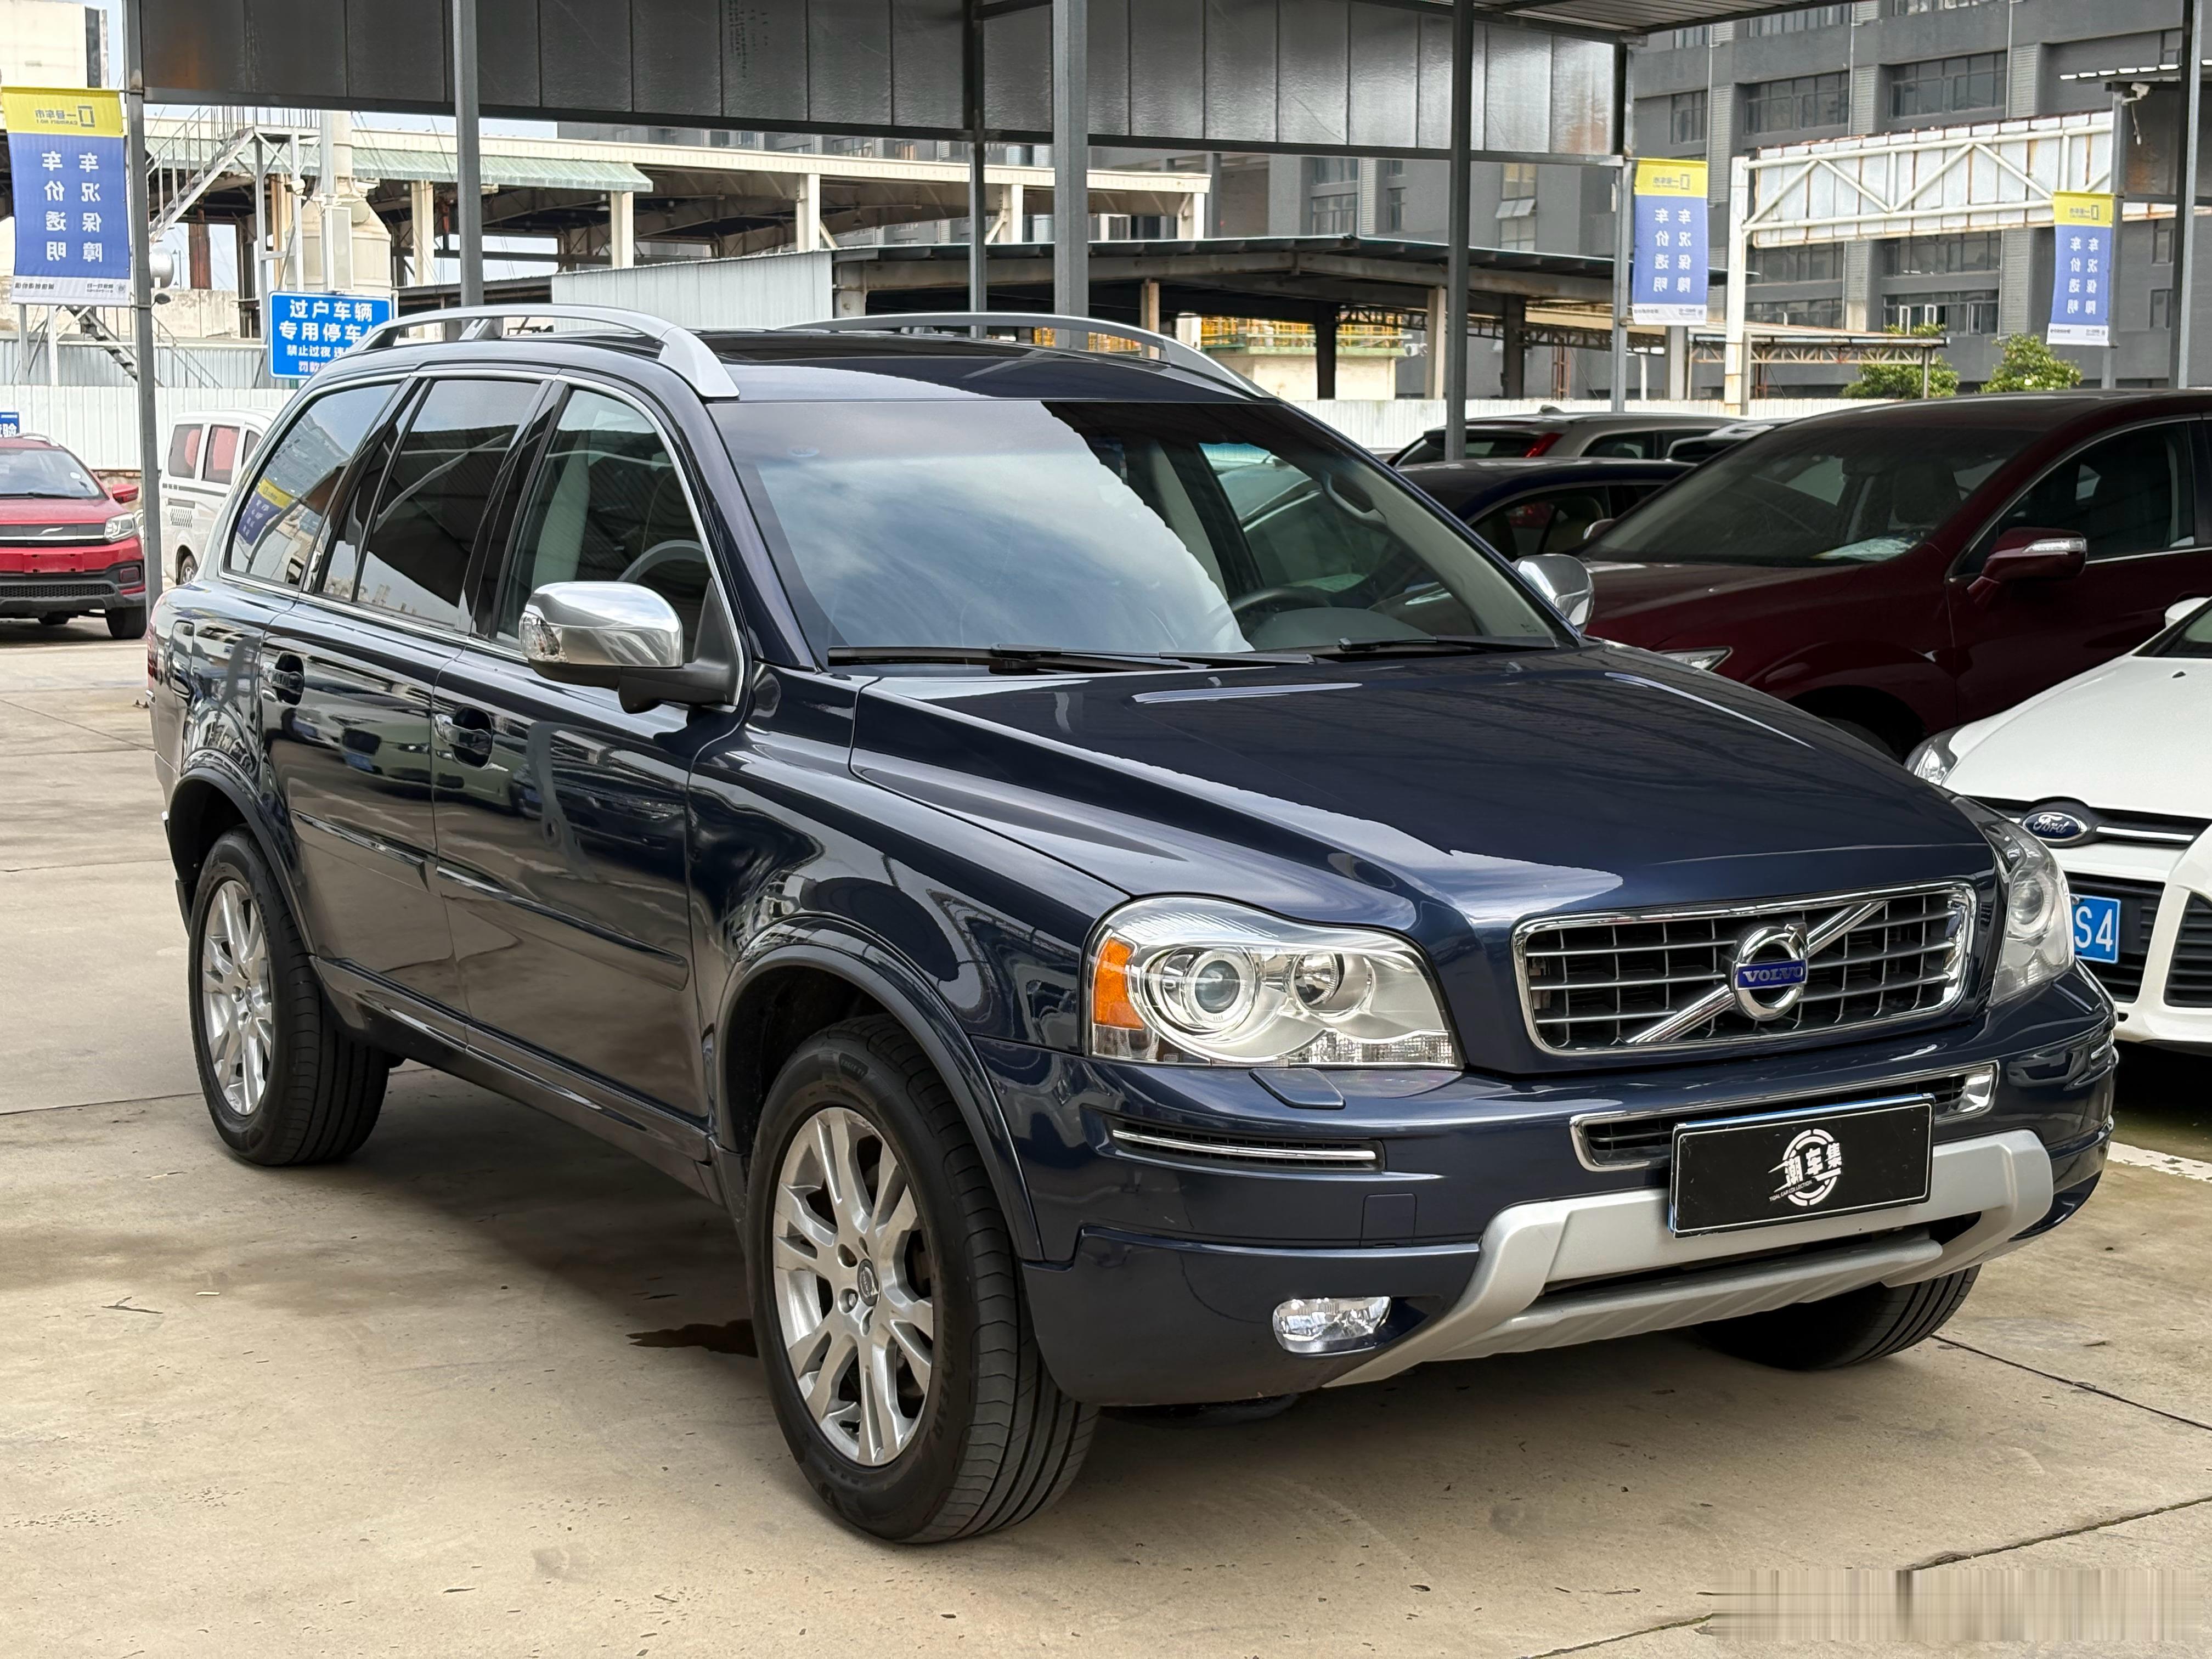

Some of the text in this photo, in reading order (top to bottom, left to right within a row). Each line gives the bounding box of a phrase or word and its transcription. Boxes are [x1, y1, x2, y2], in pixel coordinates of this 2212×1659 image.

[290, 298, 373, 322] 过户车辆
[279, 320, 373, 343] 专用停车
[287, 344, 331, 358] 禁止过夜
[298, 360, 327, 373] 罚款
[0, 423, 18, 437] 验
[2033, 814, 2070, 834] Ford
[2074, 905, 2113, 952] S4
[1743, 966, 1803, 982] VOLVO
[1784, 1142, 1843, 1187] 潮车集
